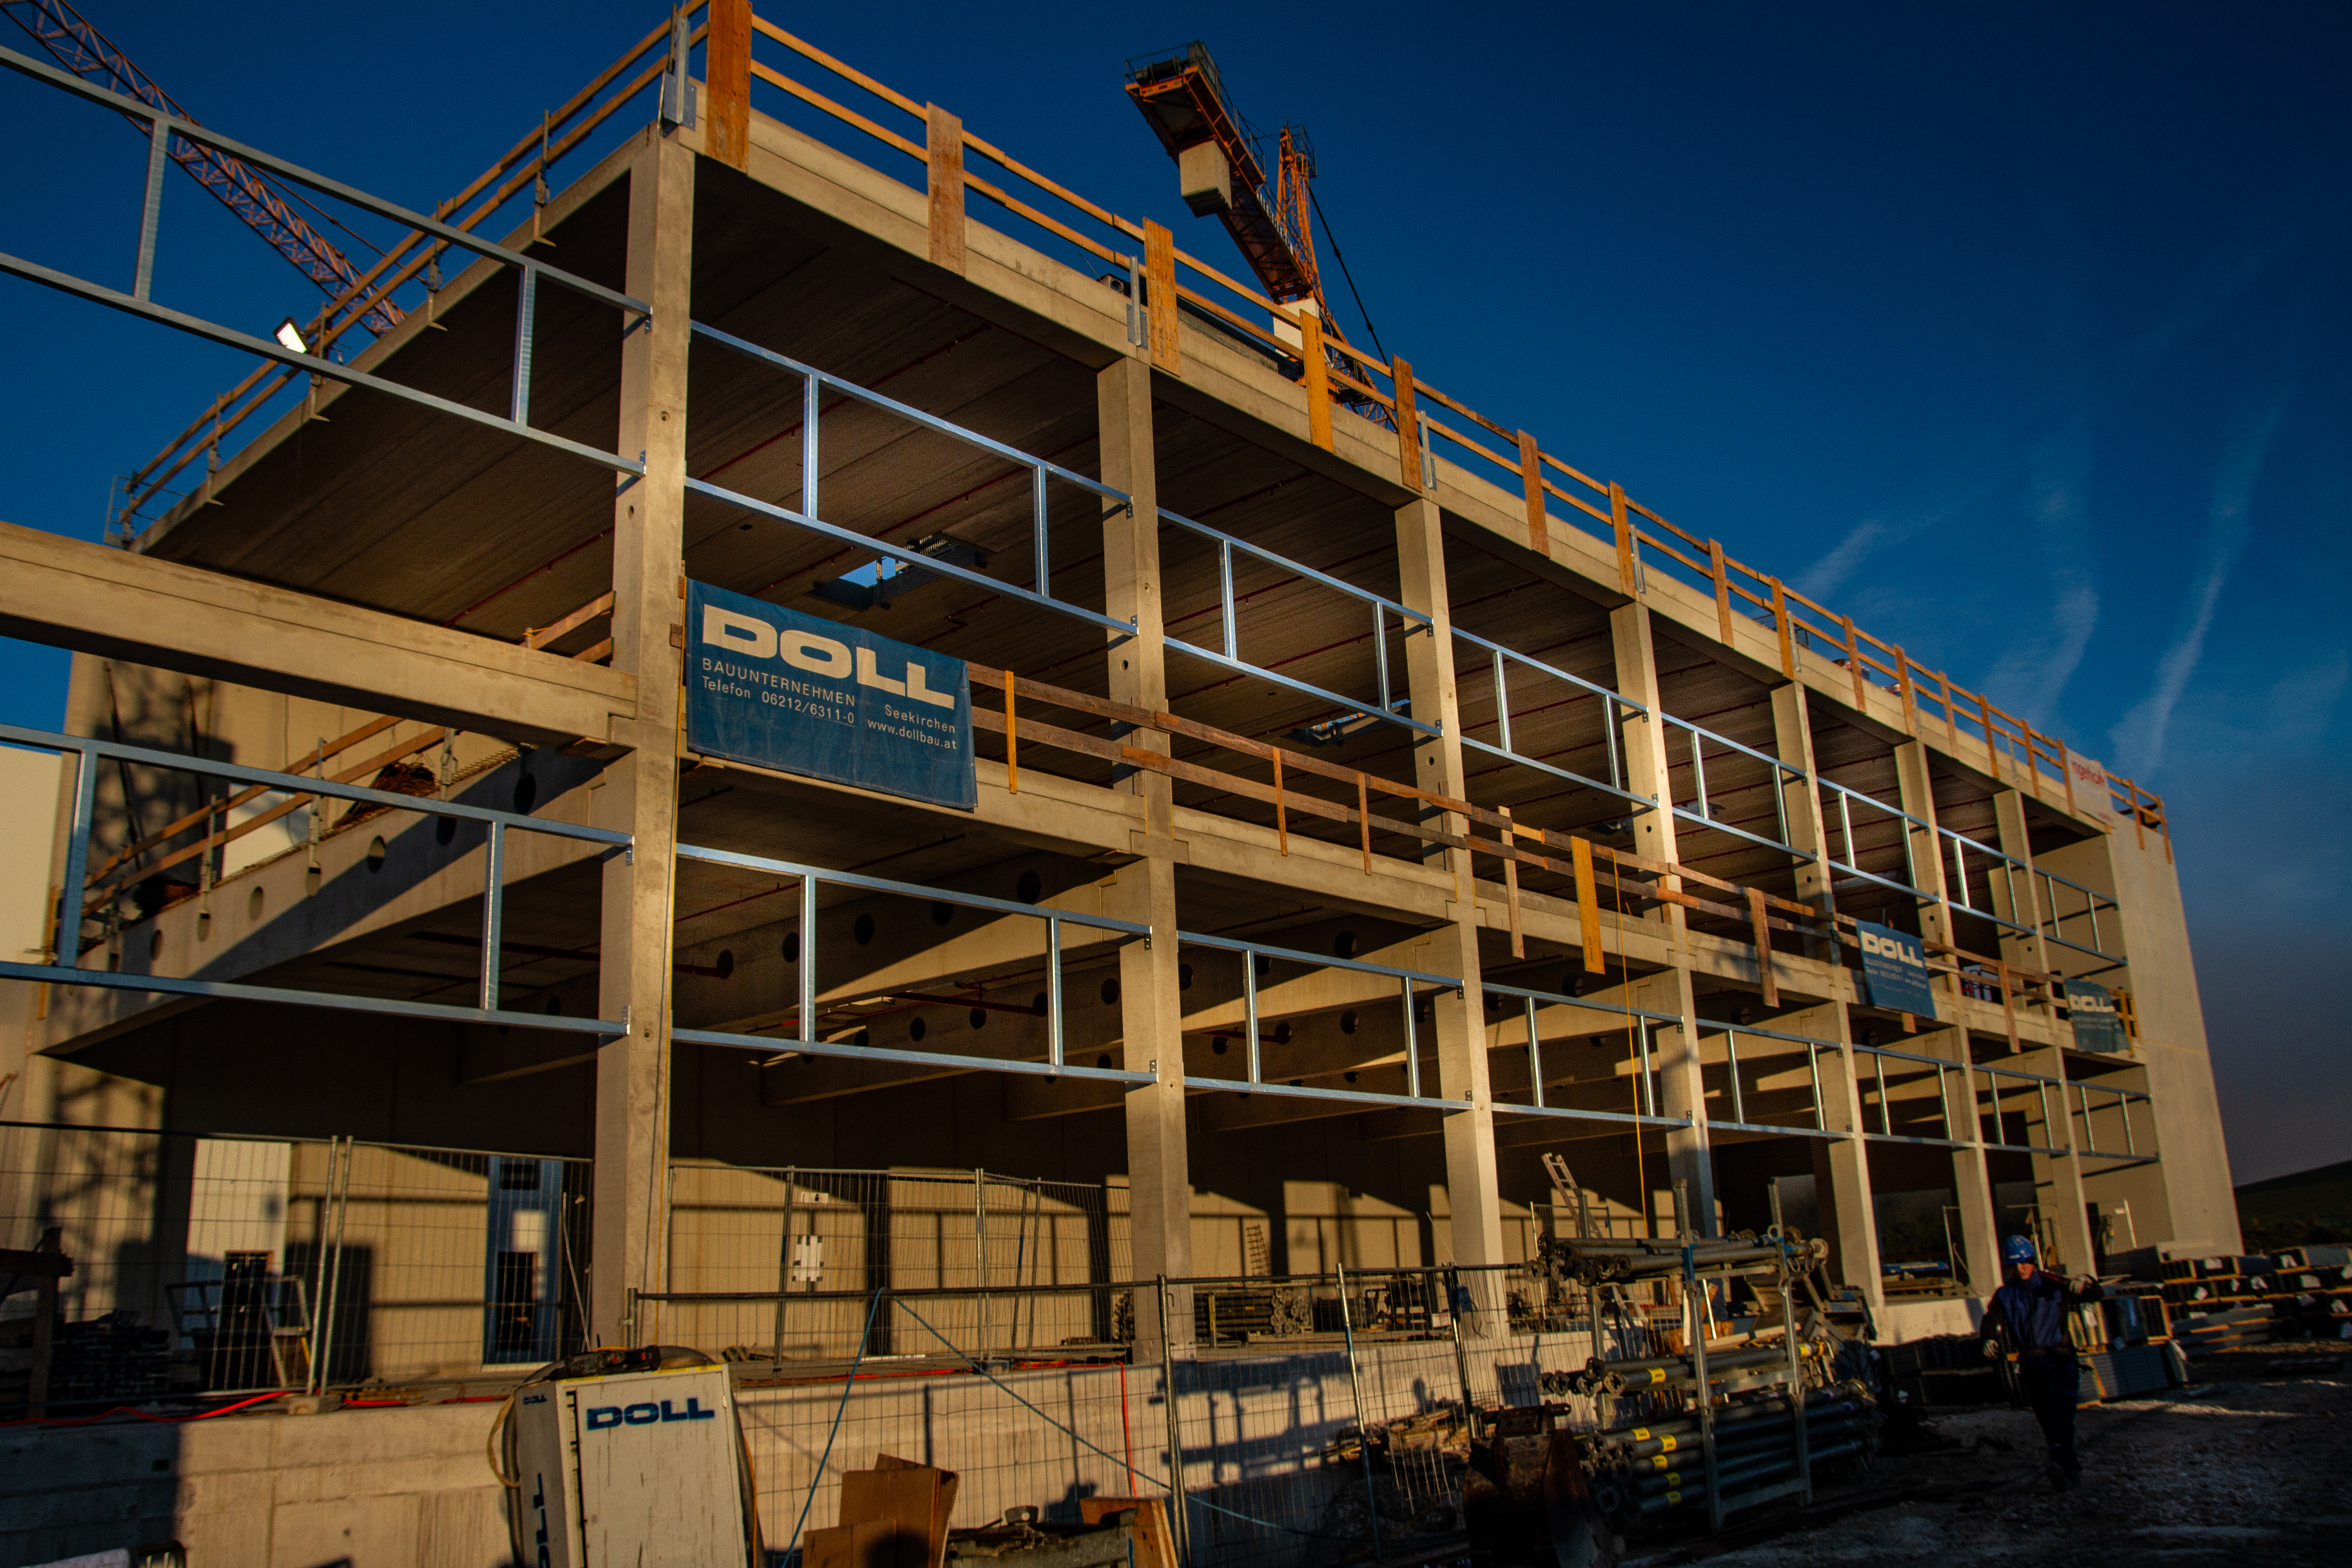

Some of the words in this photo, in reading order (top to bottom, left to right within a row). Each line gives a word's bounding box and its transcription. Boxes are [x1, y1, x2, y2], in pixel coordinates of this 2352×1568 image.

[702, 603, 955, 710] DOLL
[702, 657, 855, 707] BAUUNTERNEHMEN
[702, 676, 751, 699] Telefon
[762, 691, 854, 724] 06212/6311-0
[867, 719, 957, 749] www.dollbau.at
[885, 704, 955, 733] Seekirchen
[1861, 931, 1924, 968] DOLL
[587, 1397, 715, 1431] DOLL
